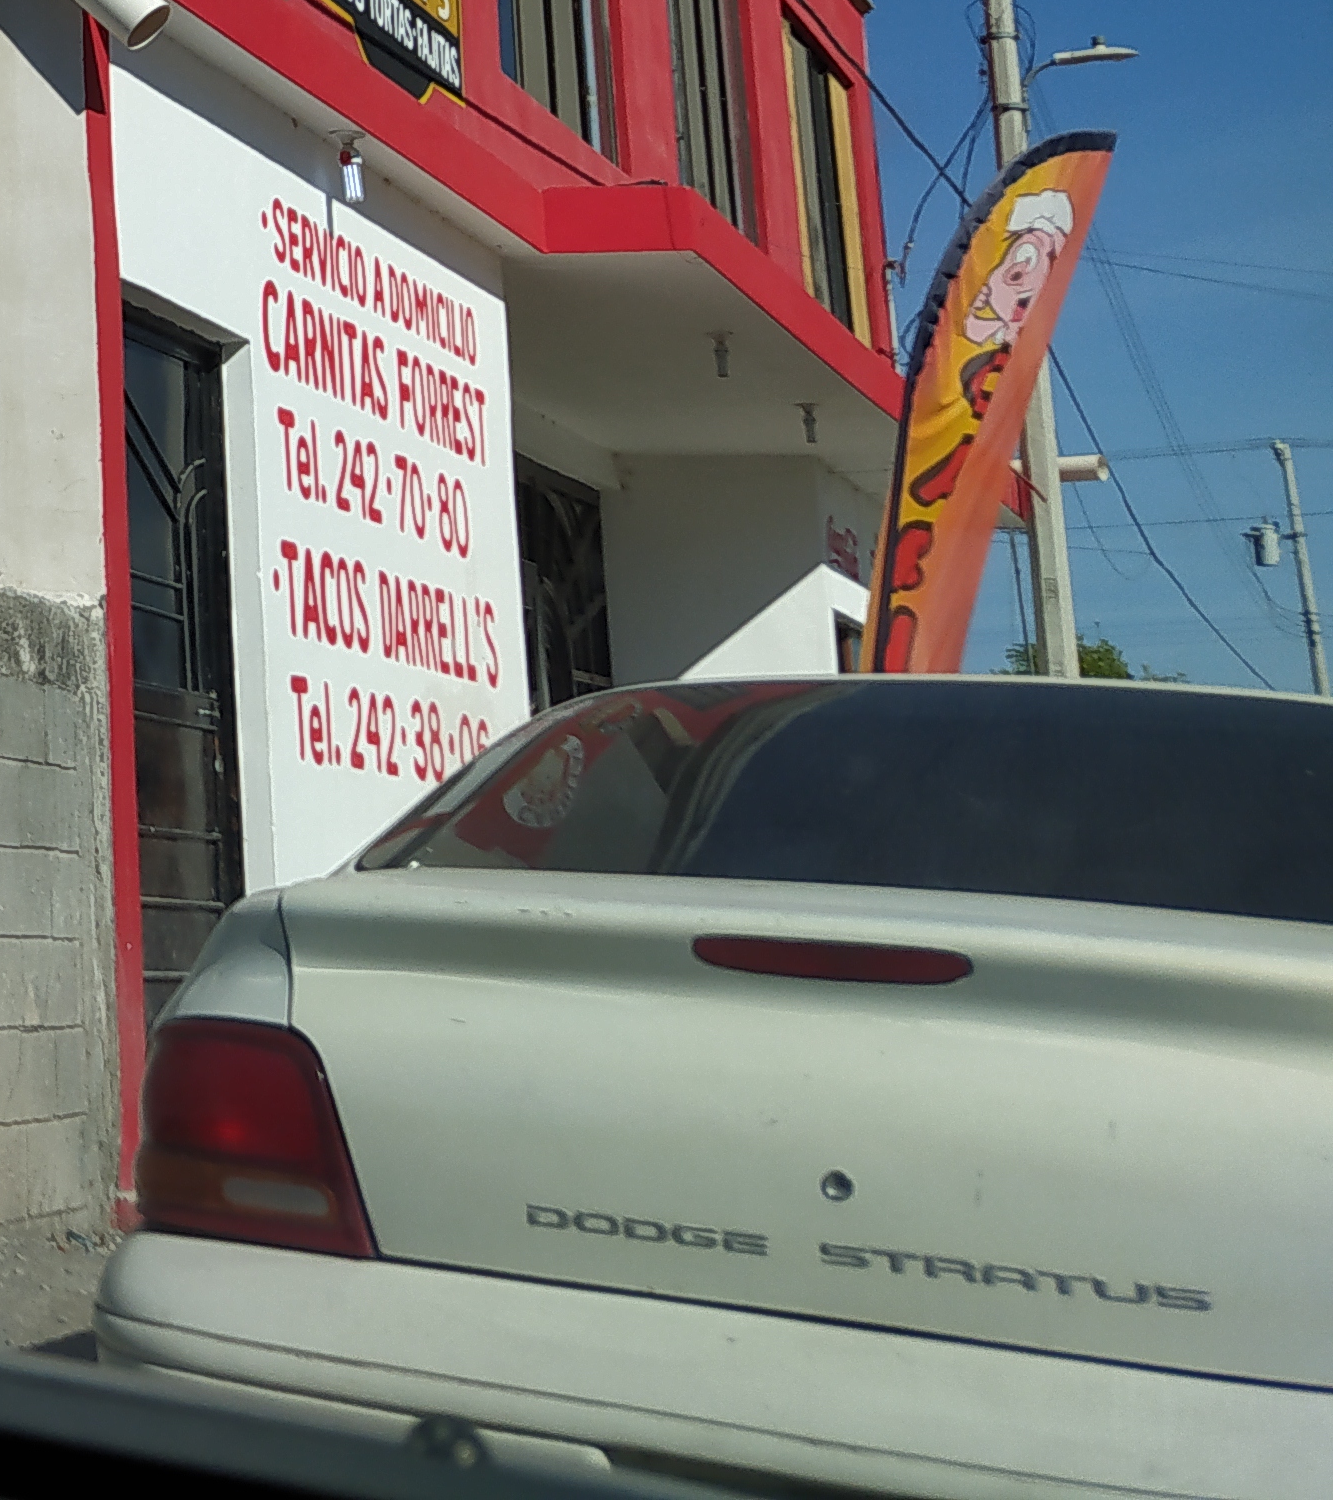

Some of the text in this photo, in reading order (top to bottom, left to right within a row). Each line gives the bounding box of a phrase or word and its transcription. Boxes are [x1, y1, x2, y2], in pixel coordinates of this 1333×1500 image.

[416, 16, 461, 88] FAJITAS
[271, 197, 477, 367] SERVICIO A DOMICILIO
[262, 279, 487, 467] CARNITAS FORREST
[277, 406, 328, 504] Tel.
[280, 538, 500, 689] TACOS DARRELL'S
[290, 674, 341, 767] Tel.
[525, 1202, 1213, 1313] DODGE STRATUS
